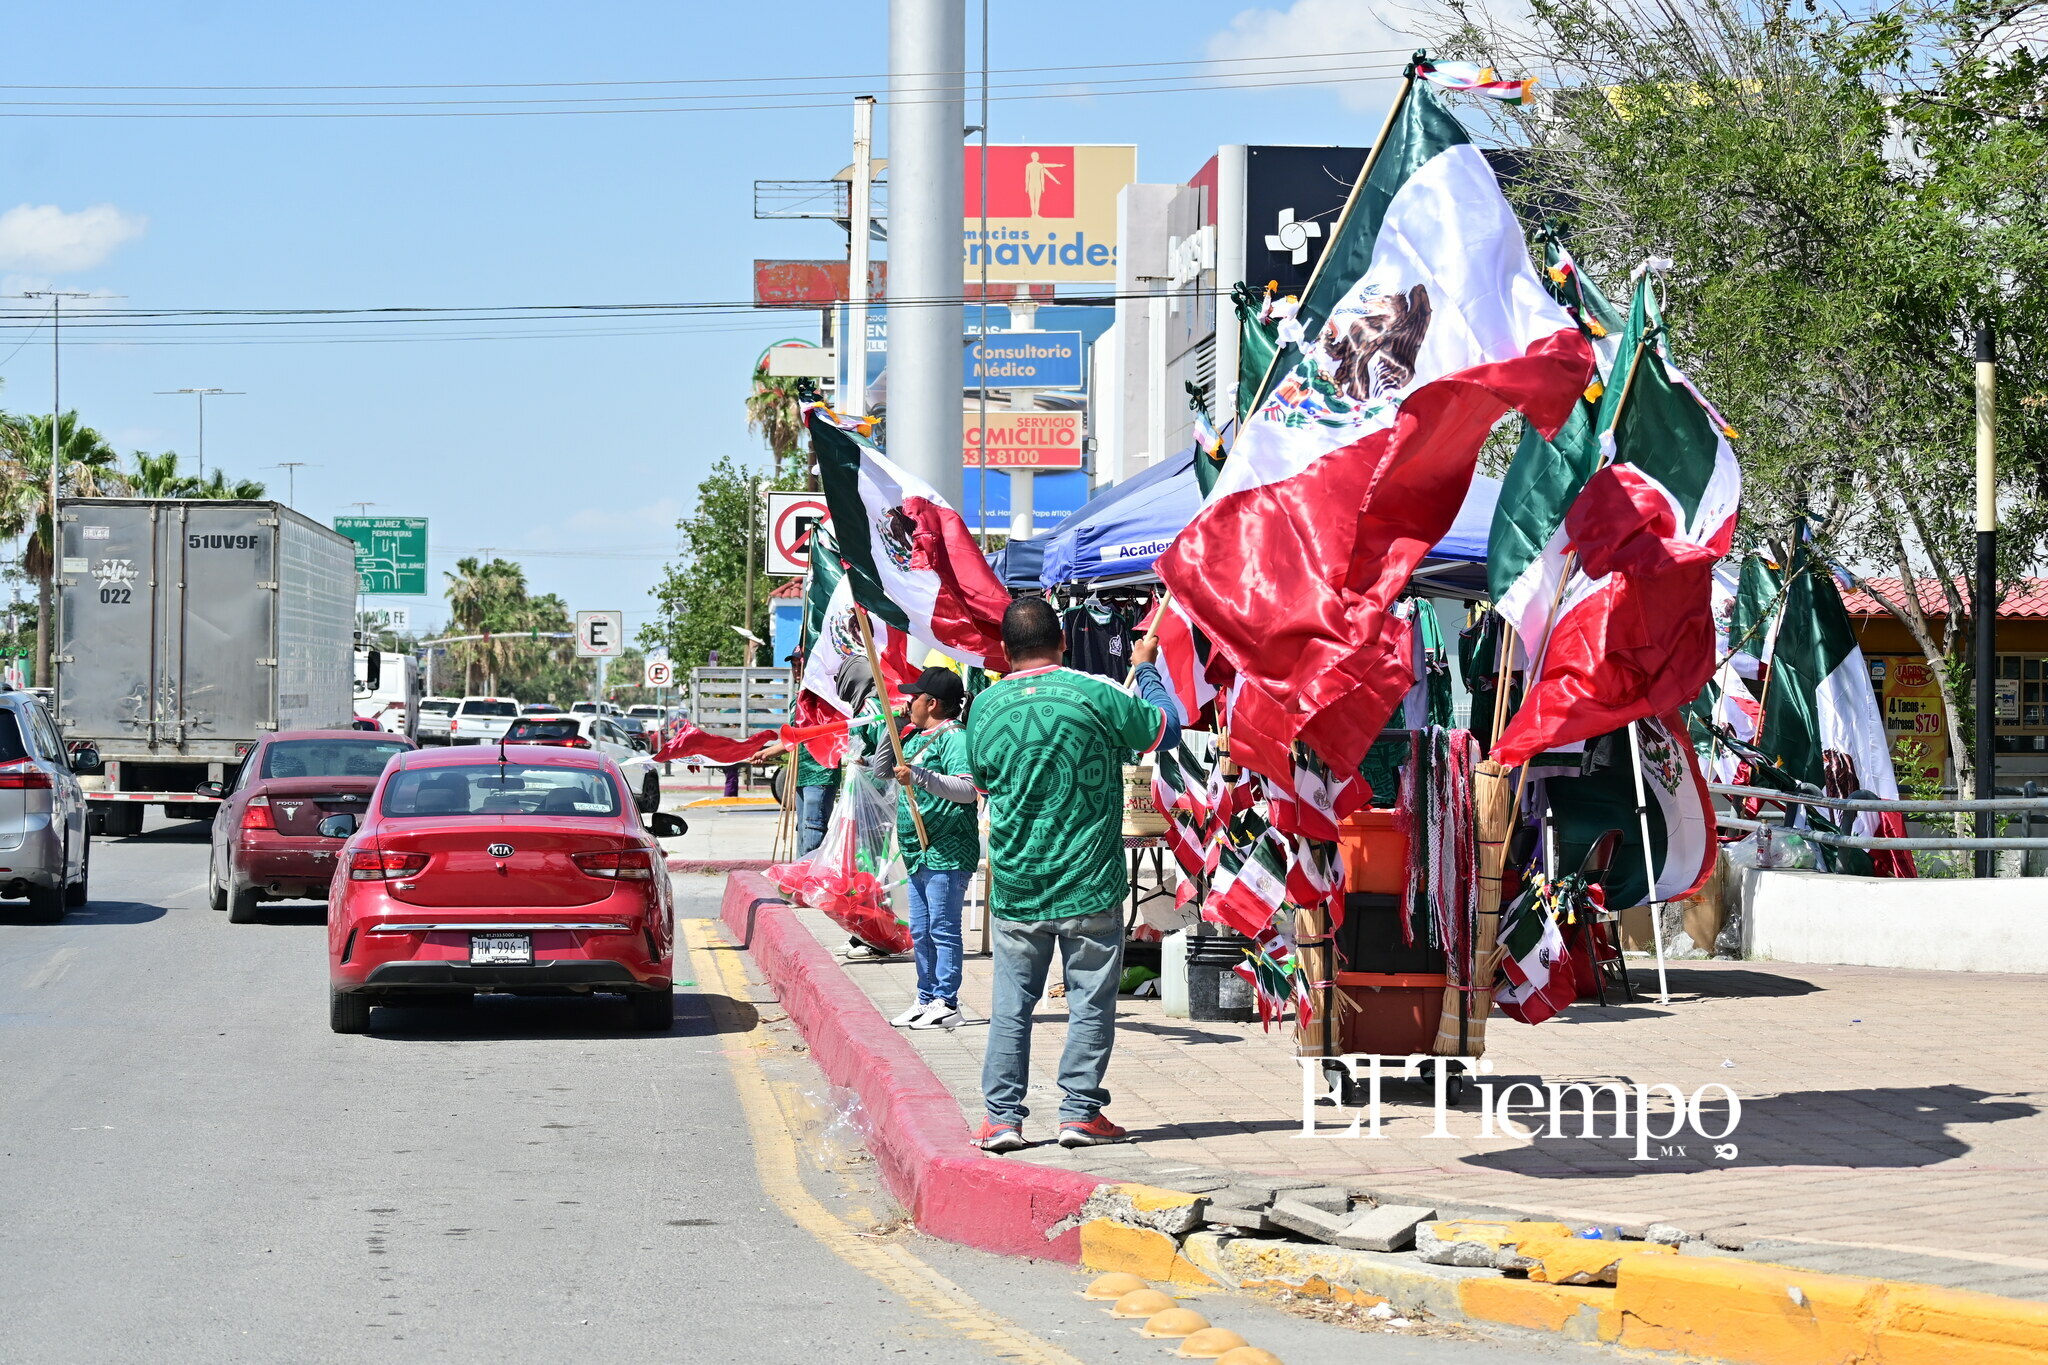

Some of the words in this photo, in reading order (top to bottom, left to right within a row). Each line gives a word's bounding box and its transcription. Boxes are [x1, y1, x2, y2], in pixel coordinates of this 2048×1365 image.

[964, 226, 1030, 240] macias
[972, 343, 1072, 360] Consultorio
[973, 362, 1036, 377] Médico
[1017, 417, 1075, 428] SERVICIO
[963, 428, 1075, 446] OMICILIO
[337, 520, 352, 528] PAR
[354, 520, 371, 528] VIAL
[373, 519, 401, 528] JUÁREZ
[188, 534, 259, 549] 51UV9F
[100, 588, 131, 604] 022
[590, 622, 608, 646] E
[1889, 697, 1896, 714] 4
[1898, 699, 1919, 713] Tacos
[1888, 717, 1915, 730] Refresco
[1915, 713, 1940, 734] $79
[491, 846, 511, 855] KIA
